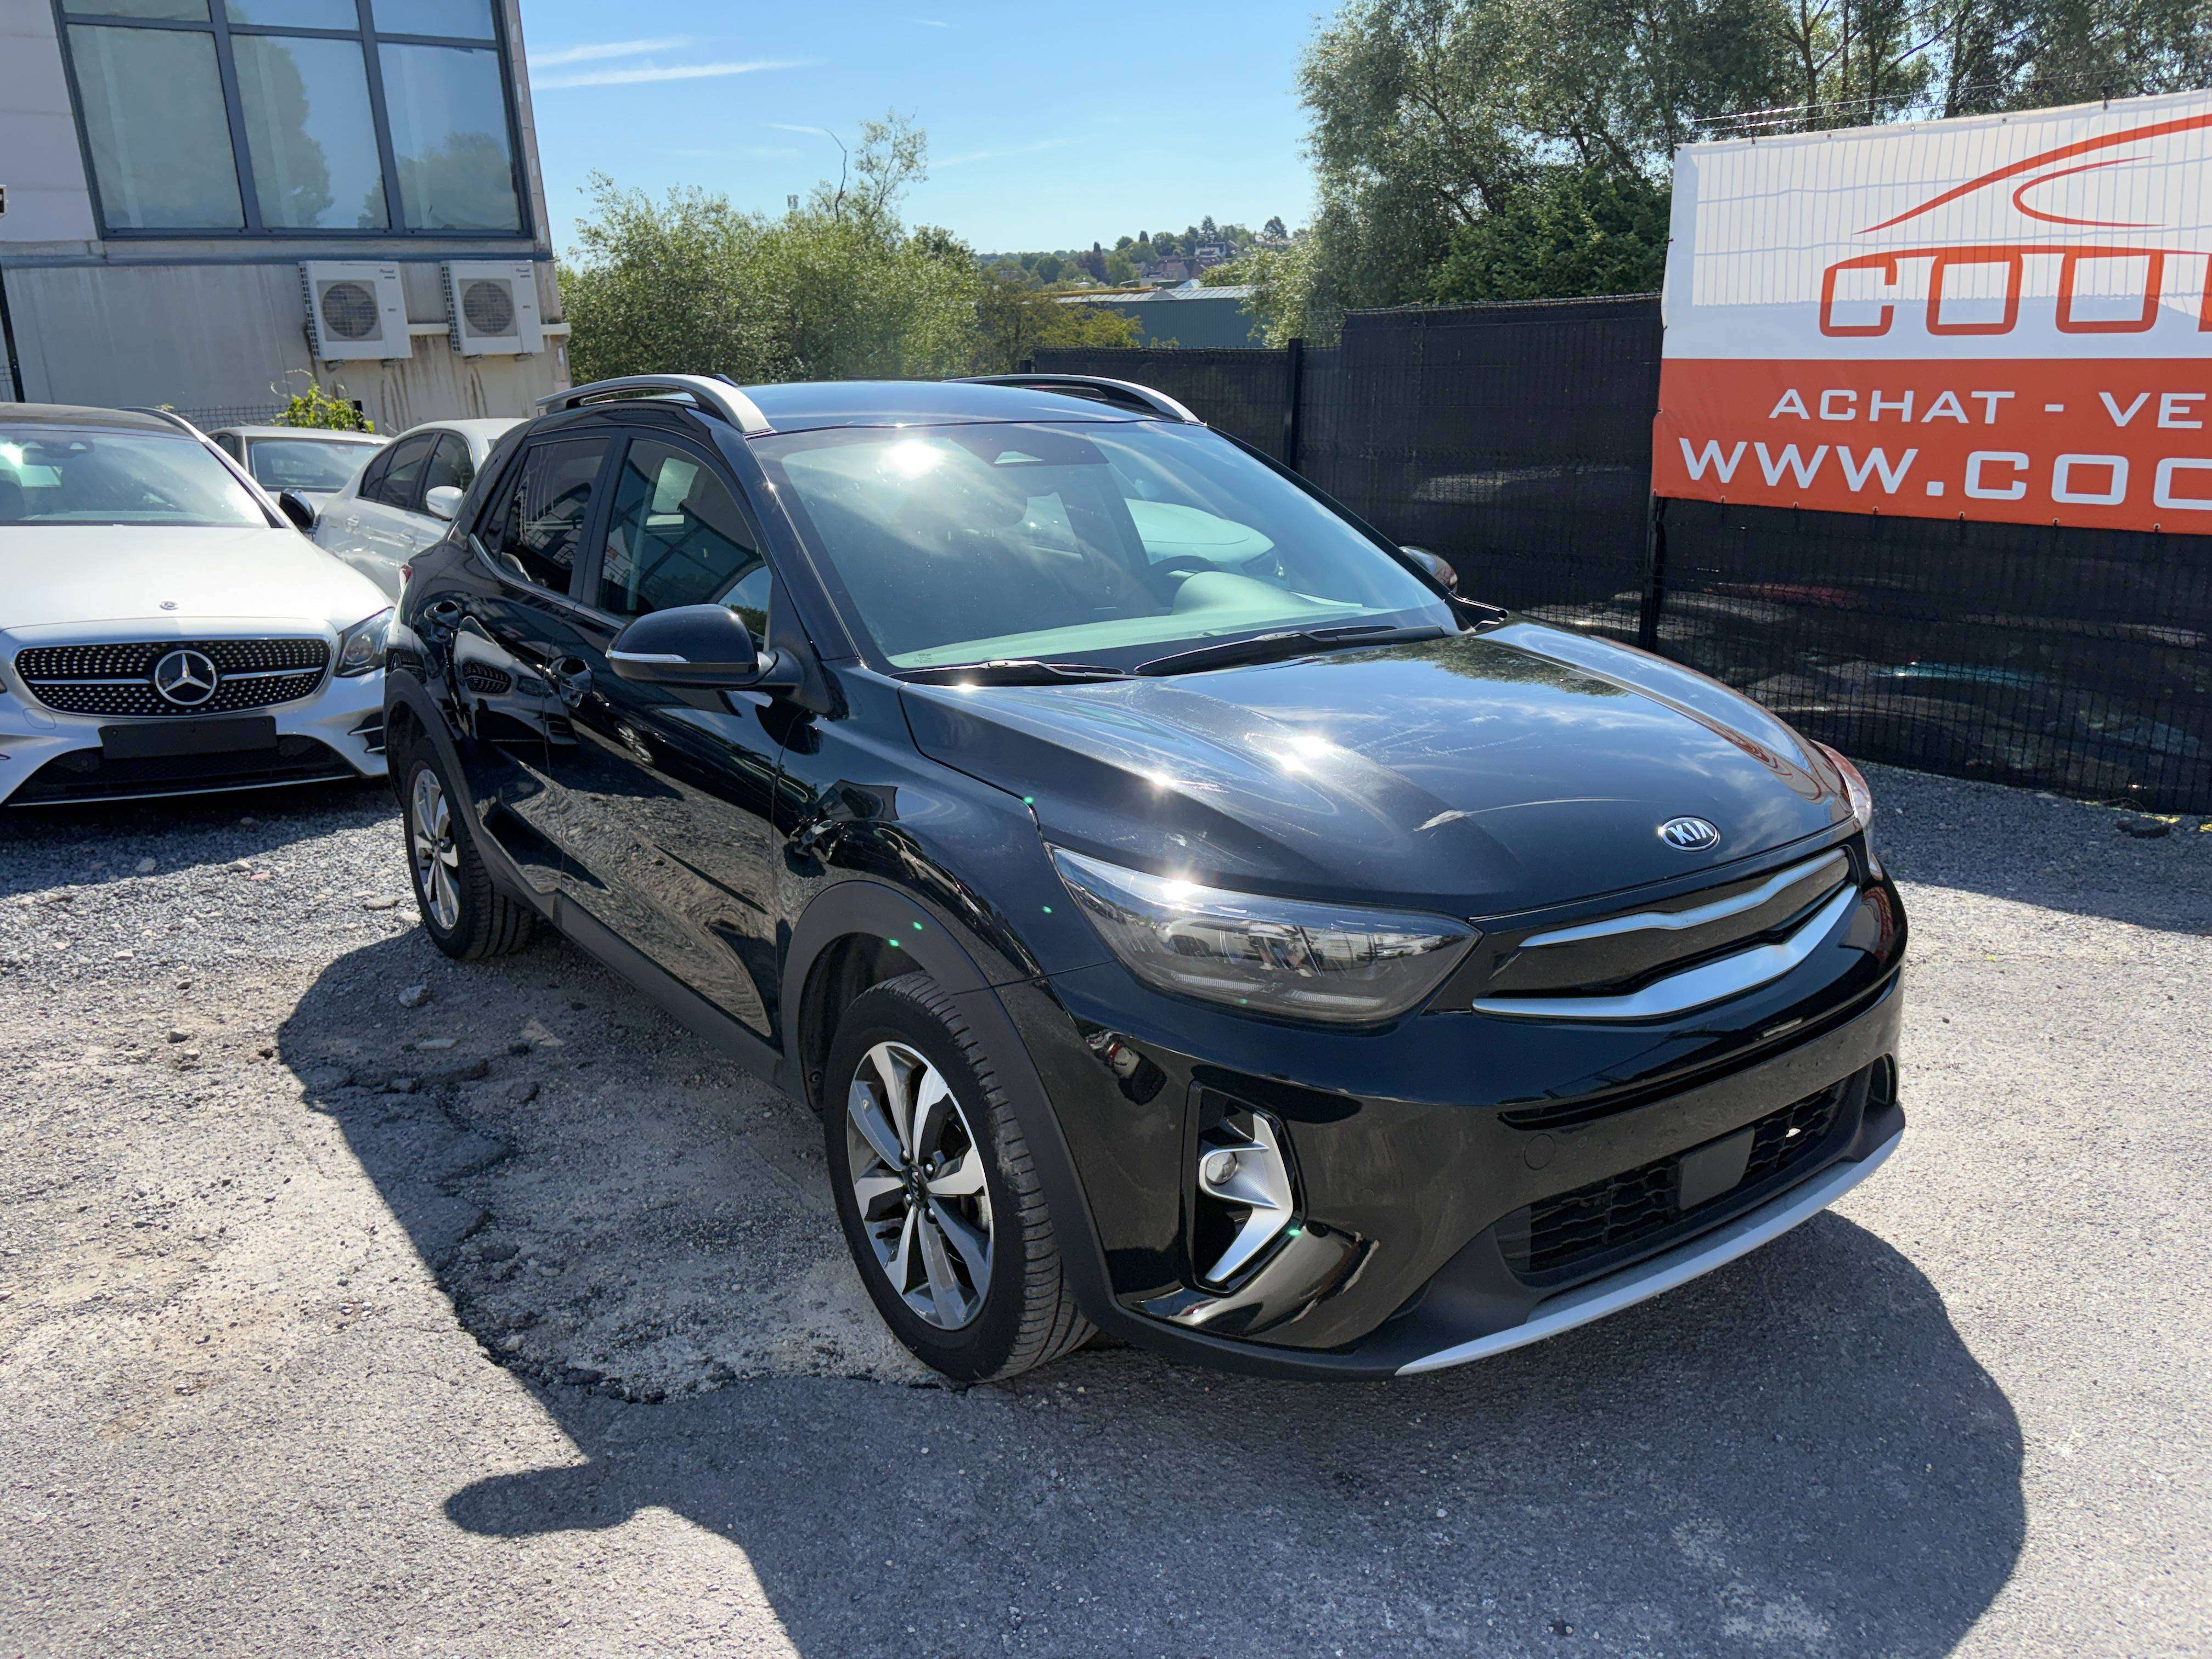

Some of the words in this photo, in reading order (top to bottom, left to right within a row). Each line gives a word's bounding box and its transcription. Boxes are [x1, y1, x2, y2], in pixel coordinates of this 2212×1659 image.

[1820, 245, 2212, 336] COO
[1769, 388, 2015, 424] ACHAT
[1668, 820, 1714, 844] KIA
